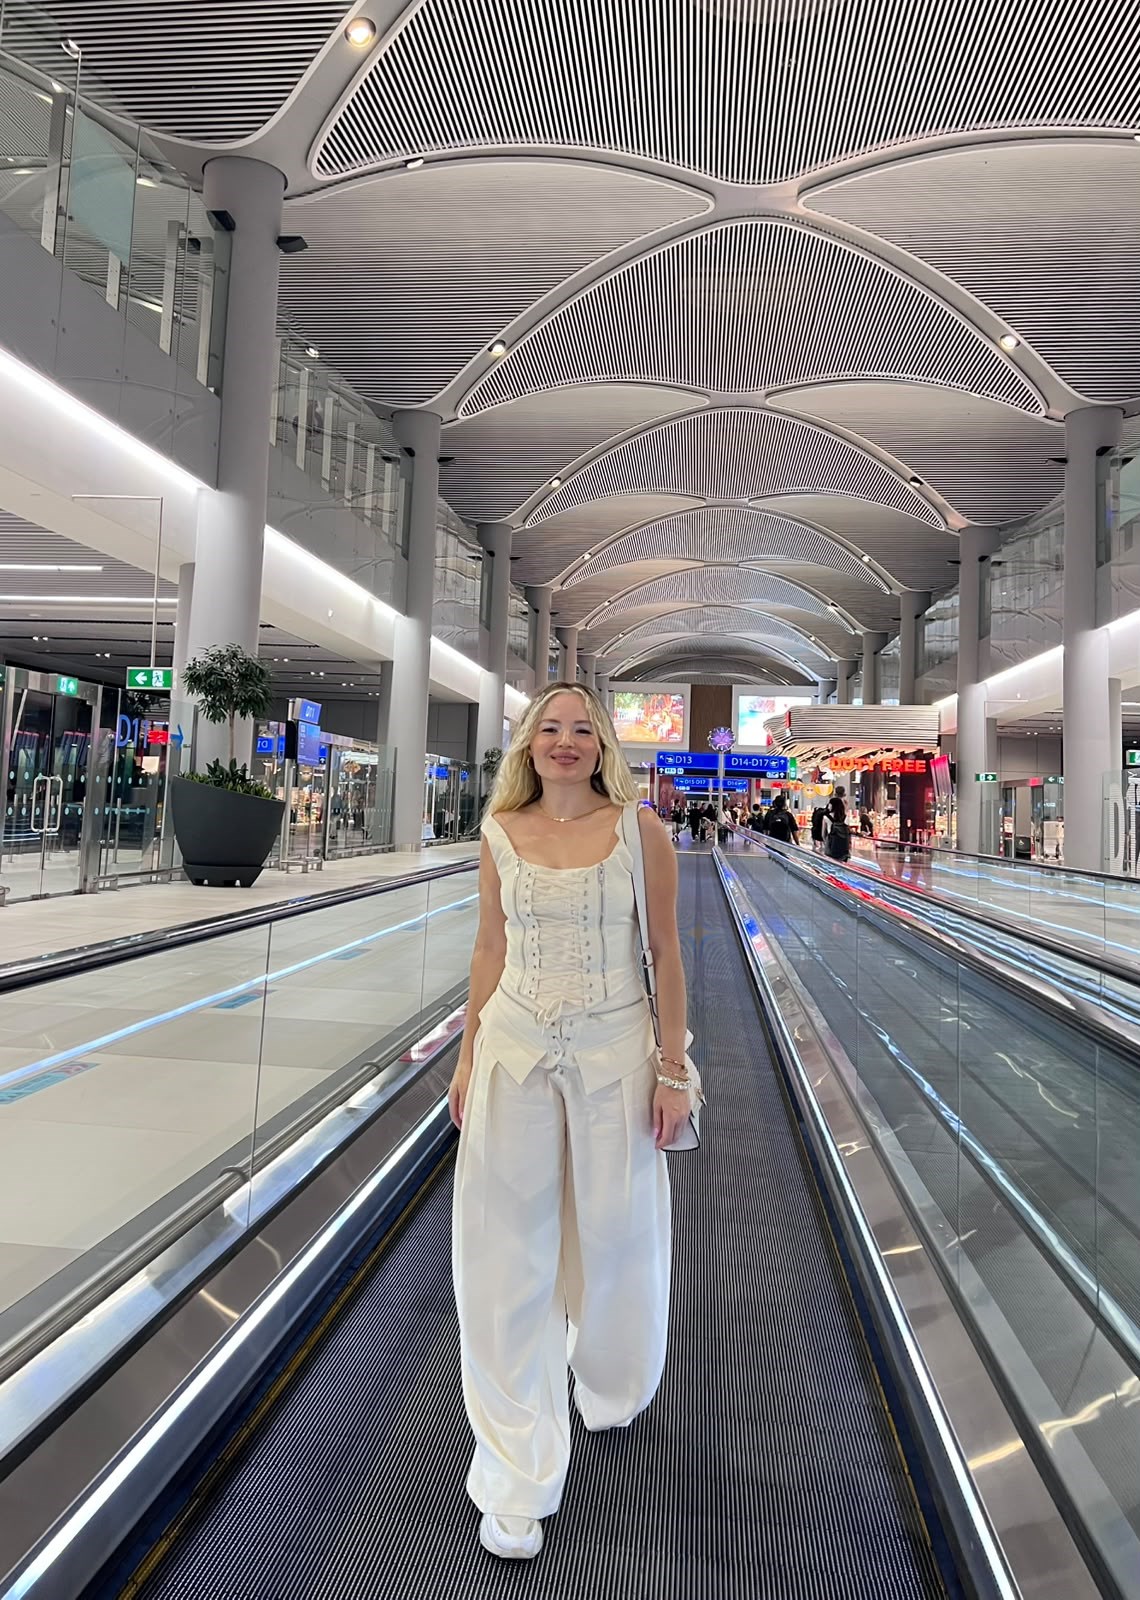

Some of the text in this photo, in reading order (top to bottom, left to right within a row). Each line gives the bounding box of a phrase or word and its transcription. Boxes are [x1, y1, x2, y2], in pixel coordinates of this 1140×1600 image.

[117, 714, 149, 749] D11
[675, 756, 692, 764] D13
[731, 757, 769, 767] D14-D17
[829, 757, 927, 773] DUTY FREE
